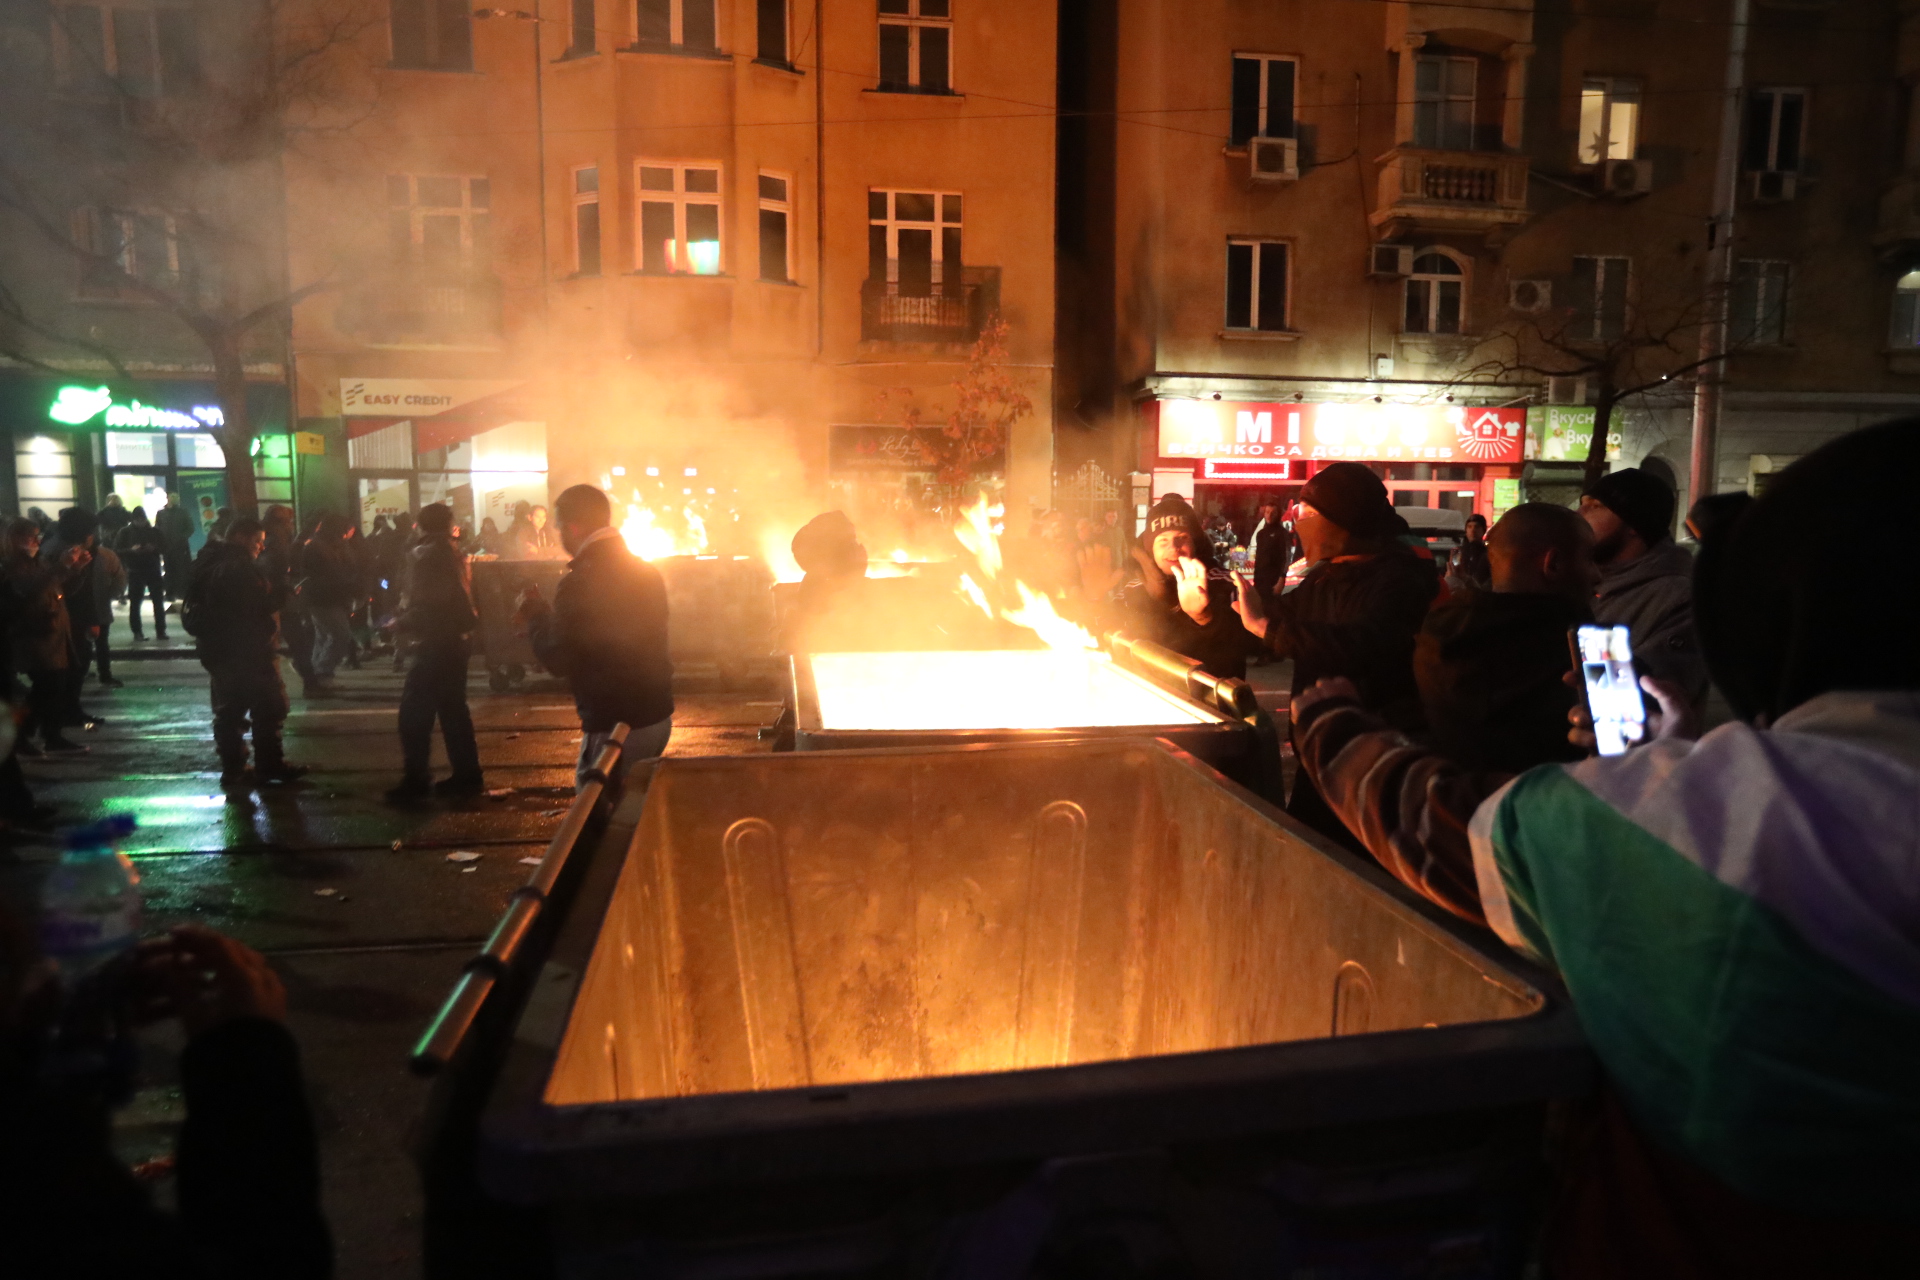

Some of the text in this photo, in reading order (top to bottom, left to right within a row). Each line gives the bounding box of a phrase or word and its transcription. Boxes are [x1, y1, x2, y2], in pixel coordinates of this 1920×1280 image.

[364, 394, 452, 406] EASY CREDIT
[1550, 408, 1596, 429] Вкусн
[1168, 443, 1453, 459] ВСИЧКО ЗА ДОМА И ТЕБ
[1150, 514, 1188, 533] FIRE
